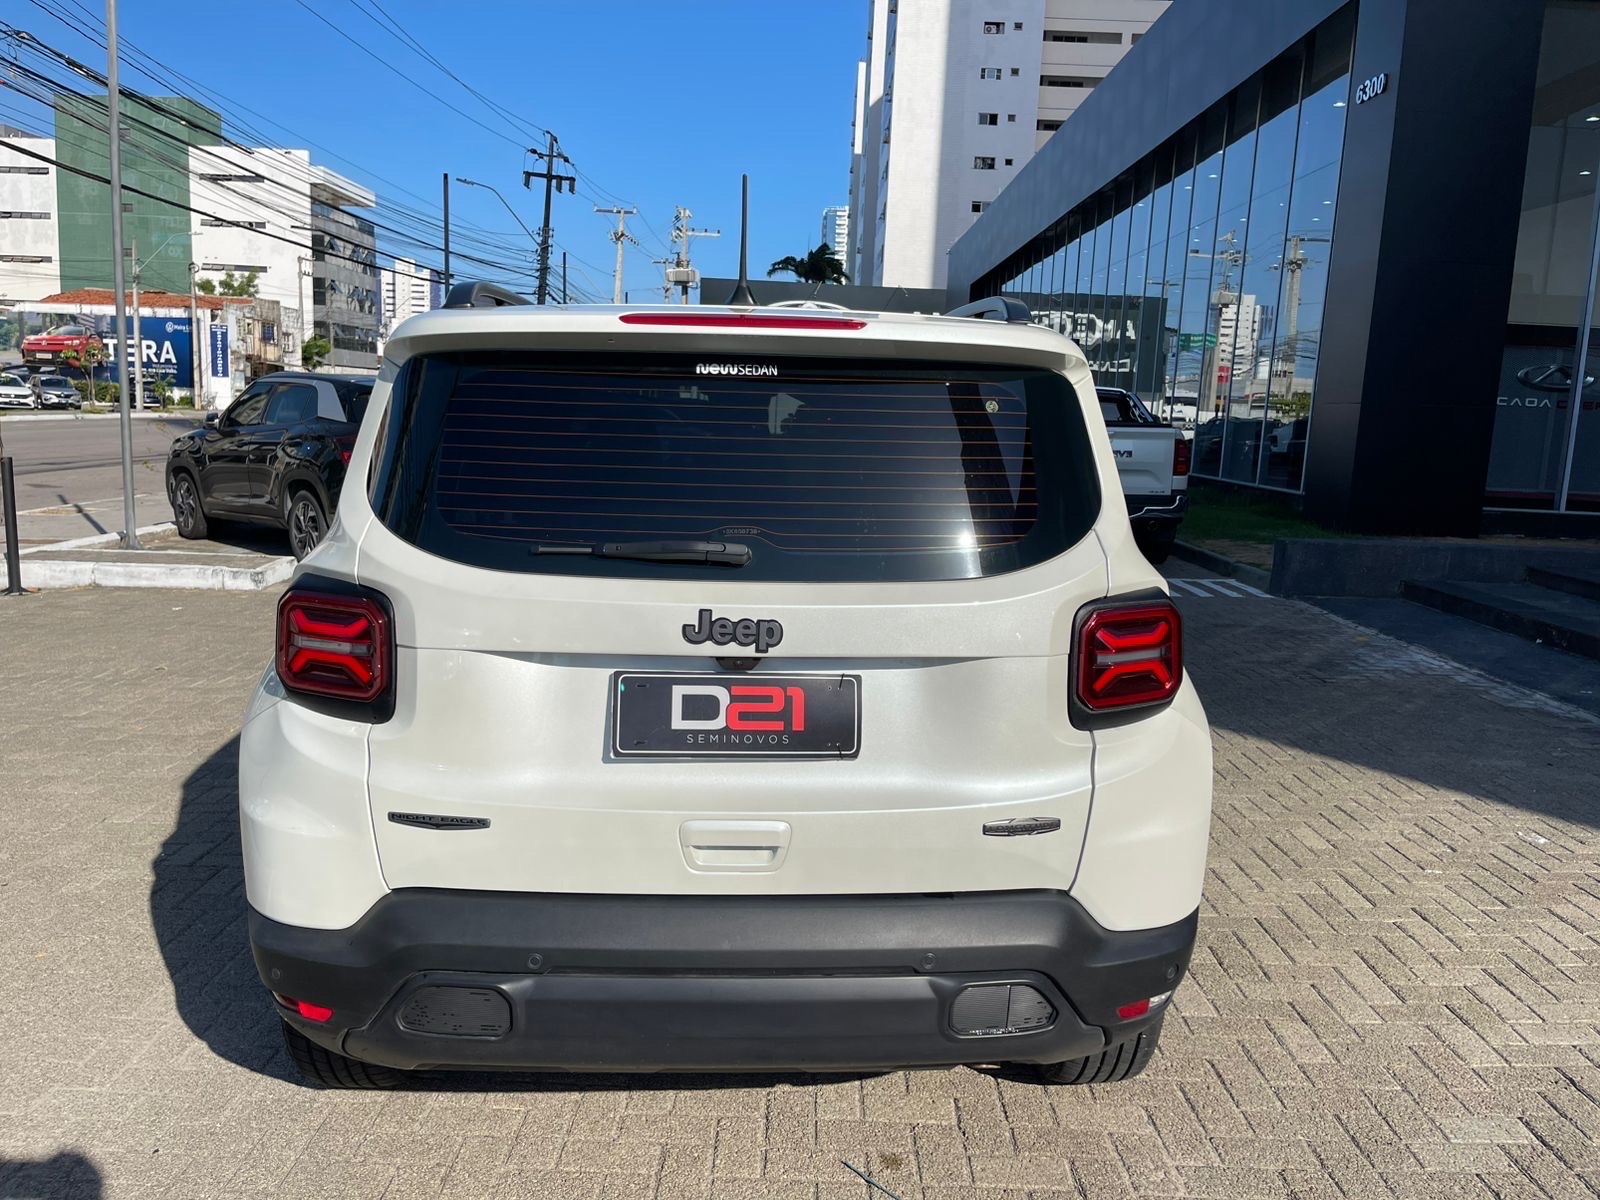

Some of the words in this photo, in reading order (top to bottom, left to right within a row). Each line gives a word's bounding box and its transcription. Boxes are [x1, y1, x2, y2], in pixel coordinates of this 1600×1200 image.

[1355, 73, 1386, 105] 6300
[682, 608, 784, 653] Jeep
[671, 684, 806, 732] D21
[686, 733, 791, 745] SEMINOVOS
[391, 813, 435, 822] NIGHT
